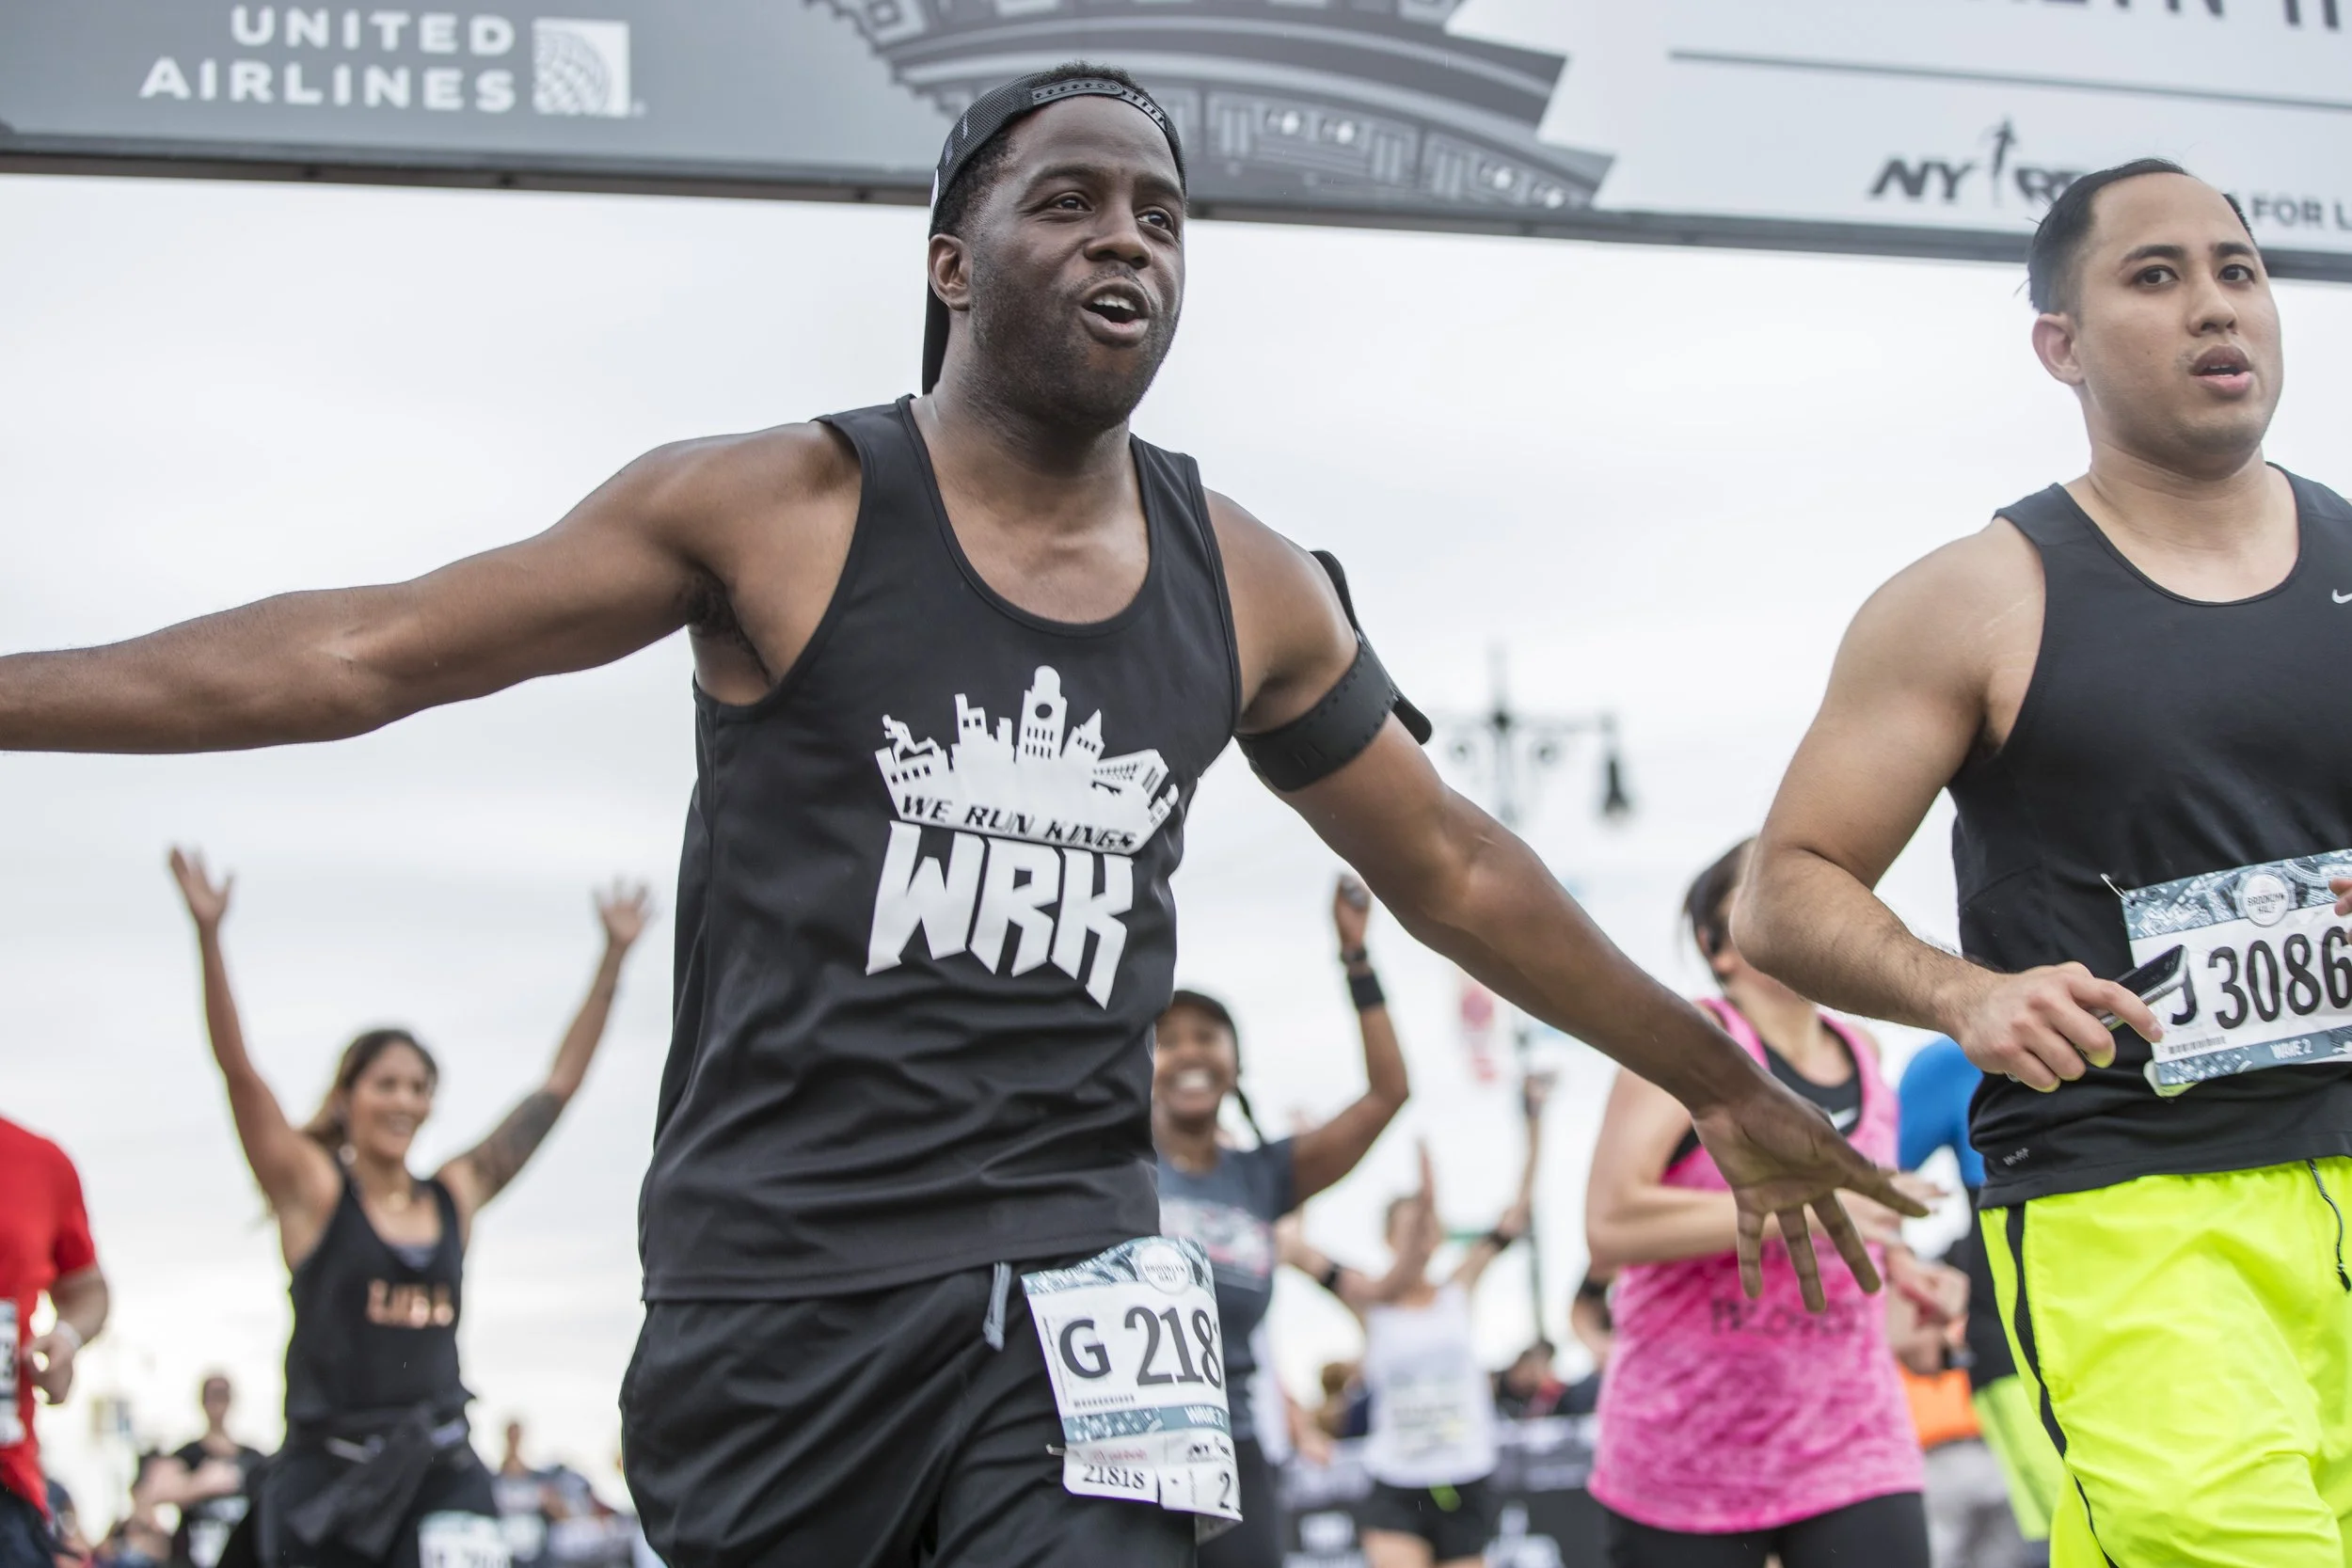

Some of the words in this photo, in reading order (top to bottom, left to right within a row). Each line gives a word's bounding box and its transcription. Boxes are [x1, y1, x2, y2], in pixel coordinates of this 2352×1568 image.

[230, 5, 516, 55] UNITED
[138, 56, 516, 113] AIRLINES
[2252, 196, 2323, 228] FOR
[901, 795, 952, 824] WE
[965, 805, 1034, 836] RUN
[1044, 820, 1136, 848] KINGS
[866, 820, 1134, 1010] WRK
[2207, 926, 2352, 1030] 3086
[1059, 1319, 1112, 1379] G
